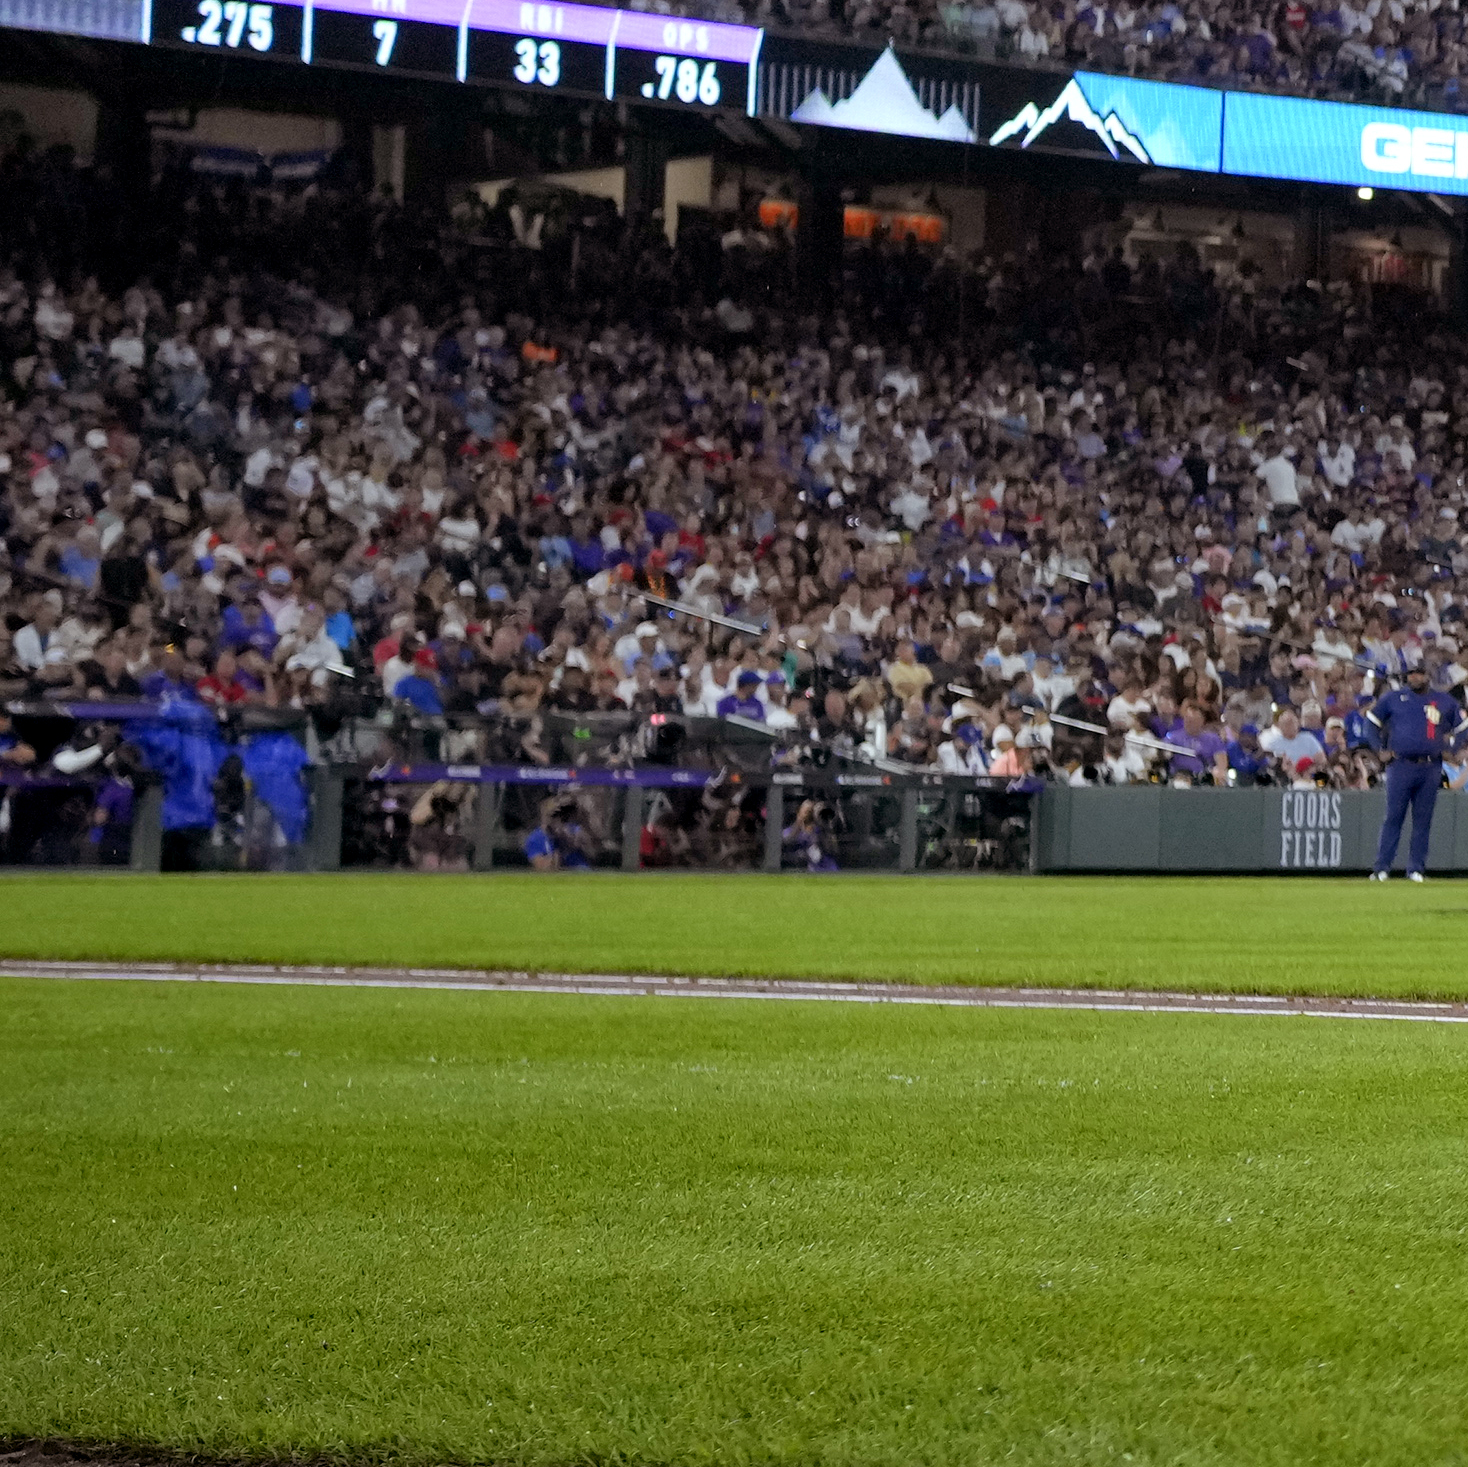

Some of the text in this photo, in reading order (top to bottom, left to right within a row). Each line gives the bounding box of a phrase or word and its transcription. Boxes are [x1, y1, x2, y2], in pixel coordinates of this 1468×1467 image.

[372, 19, 398, 67] 7
[662, 21, 709, 53] OPS
[513, 38, 561, 87] 33
[641, 56, 721, 106] .786
[1282, 792, 1342, 827] COORS
[1281, 832, 1342, 867] FIELD
